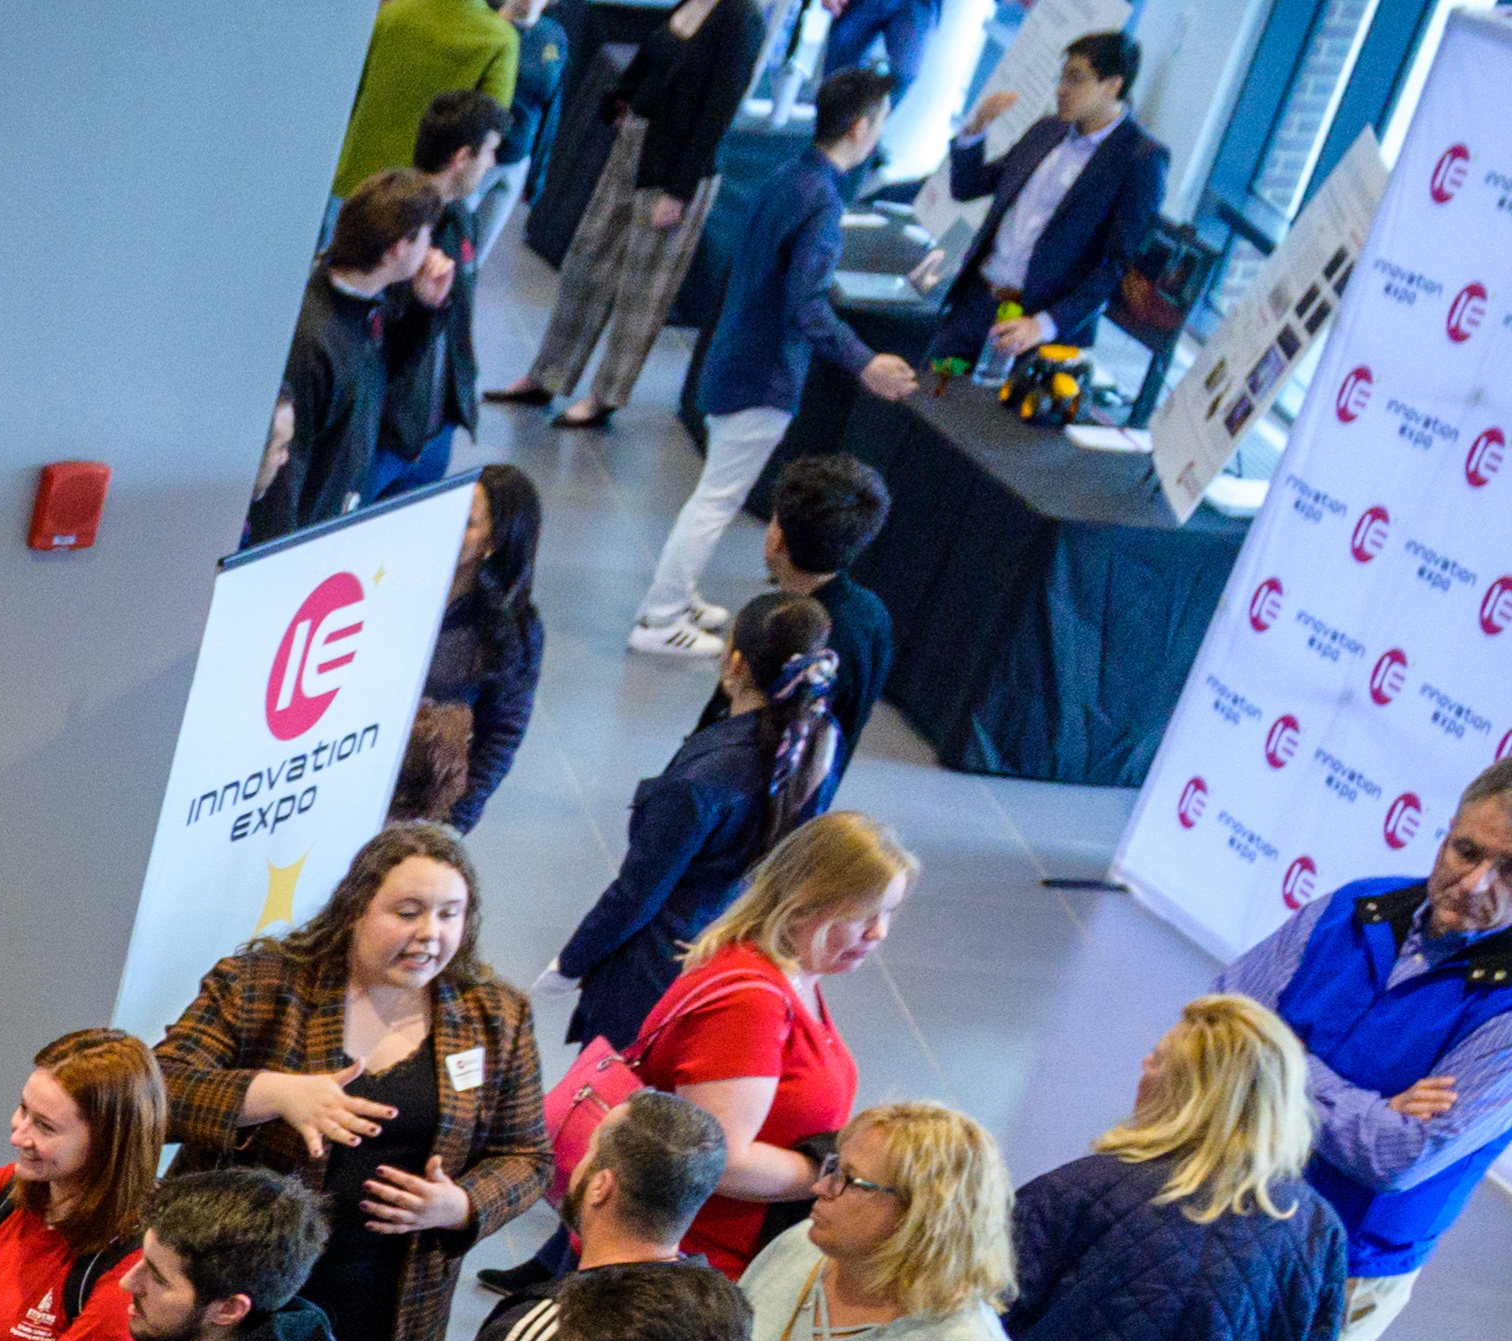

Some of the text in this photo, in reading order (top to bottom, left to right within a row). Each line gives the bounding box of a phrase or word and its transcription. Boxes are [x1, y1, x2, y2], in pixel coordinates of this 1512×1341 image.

[1373, 258, 1444, 296] innovation
[1384, 281, 1417, 306] expo
[1386, 399, 1459, 443] innovation
[1398, 423, 1433, 450] expo
[1286, 474, 1347, 516] innovation
[1294, 500, 1323, 524] expo
[1404, 539, 1477, 587] innovation
[1418, 566, 1451, 592] expo
[1296, 609, 1366, 656] innovation
[1308, 636, 1341, 662] expo
[270, 588, 364, 722] IE
[1206, 675, 1263, 721] innovation
[1214, 699, 1241, 725] expo
[1420, 682, 1492, 736] innovation
[1430, 710, 1465, 739] expo
[187, 722, 379, 826] innovation
[1315, 747, 1382, 798] innovation
[1325, 775, 1357, 802] expo
[231, 785, 317, 841] expo
[1218, 810, 1279, 860] innovation
[1228, 836, 1257, 864] expo
